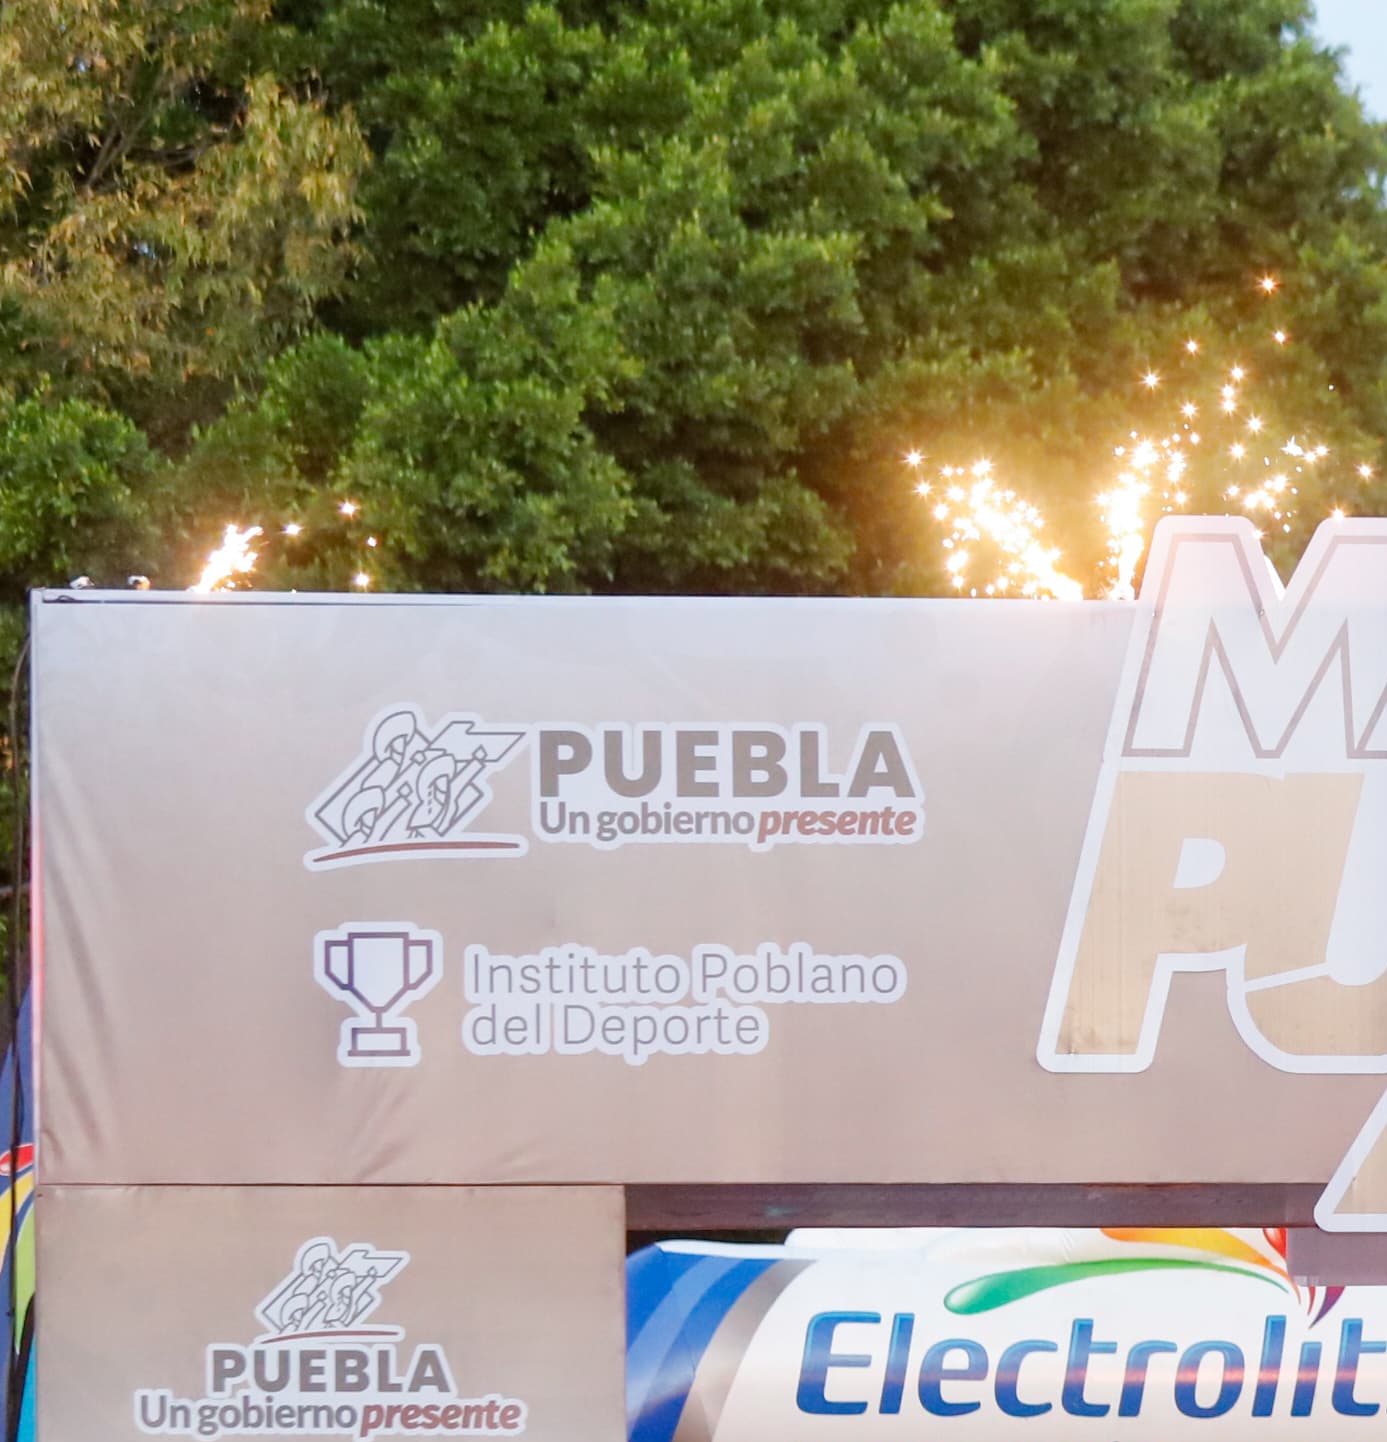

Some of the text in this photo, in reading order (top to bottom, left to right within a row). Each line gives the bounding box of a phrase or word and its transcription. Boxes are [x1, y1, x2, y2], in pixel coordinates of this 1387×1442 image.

[540, 730, 915, 798] PUEBLA
[540, 802, 917, 843] Un gobierno presente
[472, 951, 899, 995] Instituto Poblano
[472, 1003, 761, 1054] del Deporte
[212, 1350, 450, 1393] PUEBLA
[795, 1311, 1387, 1420] Electrolit
[140, 1396, 521, 1437] Un gobierno presente
